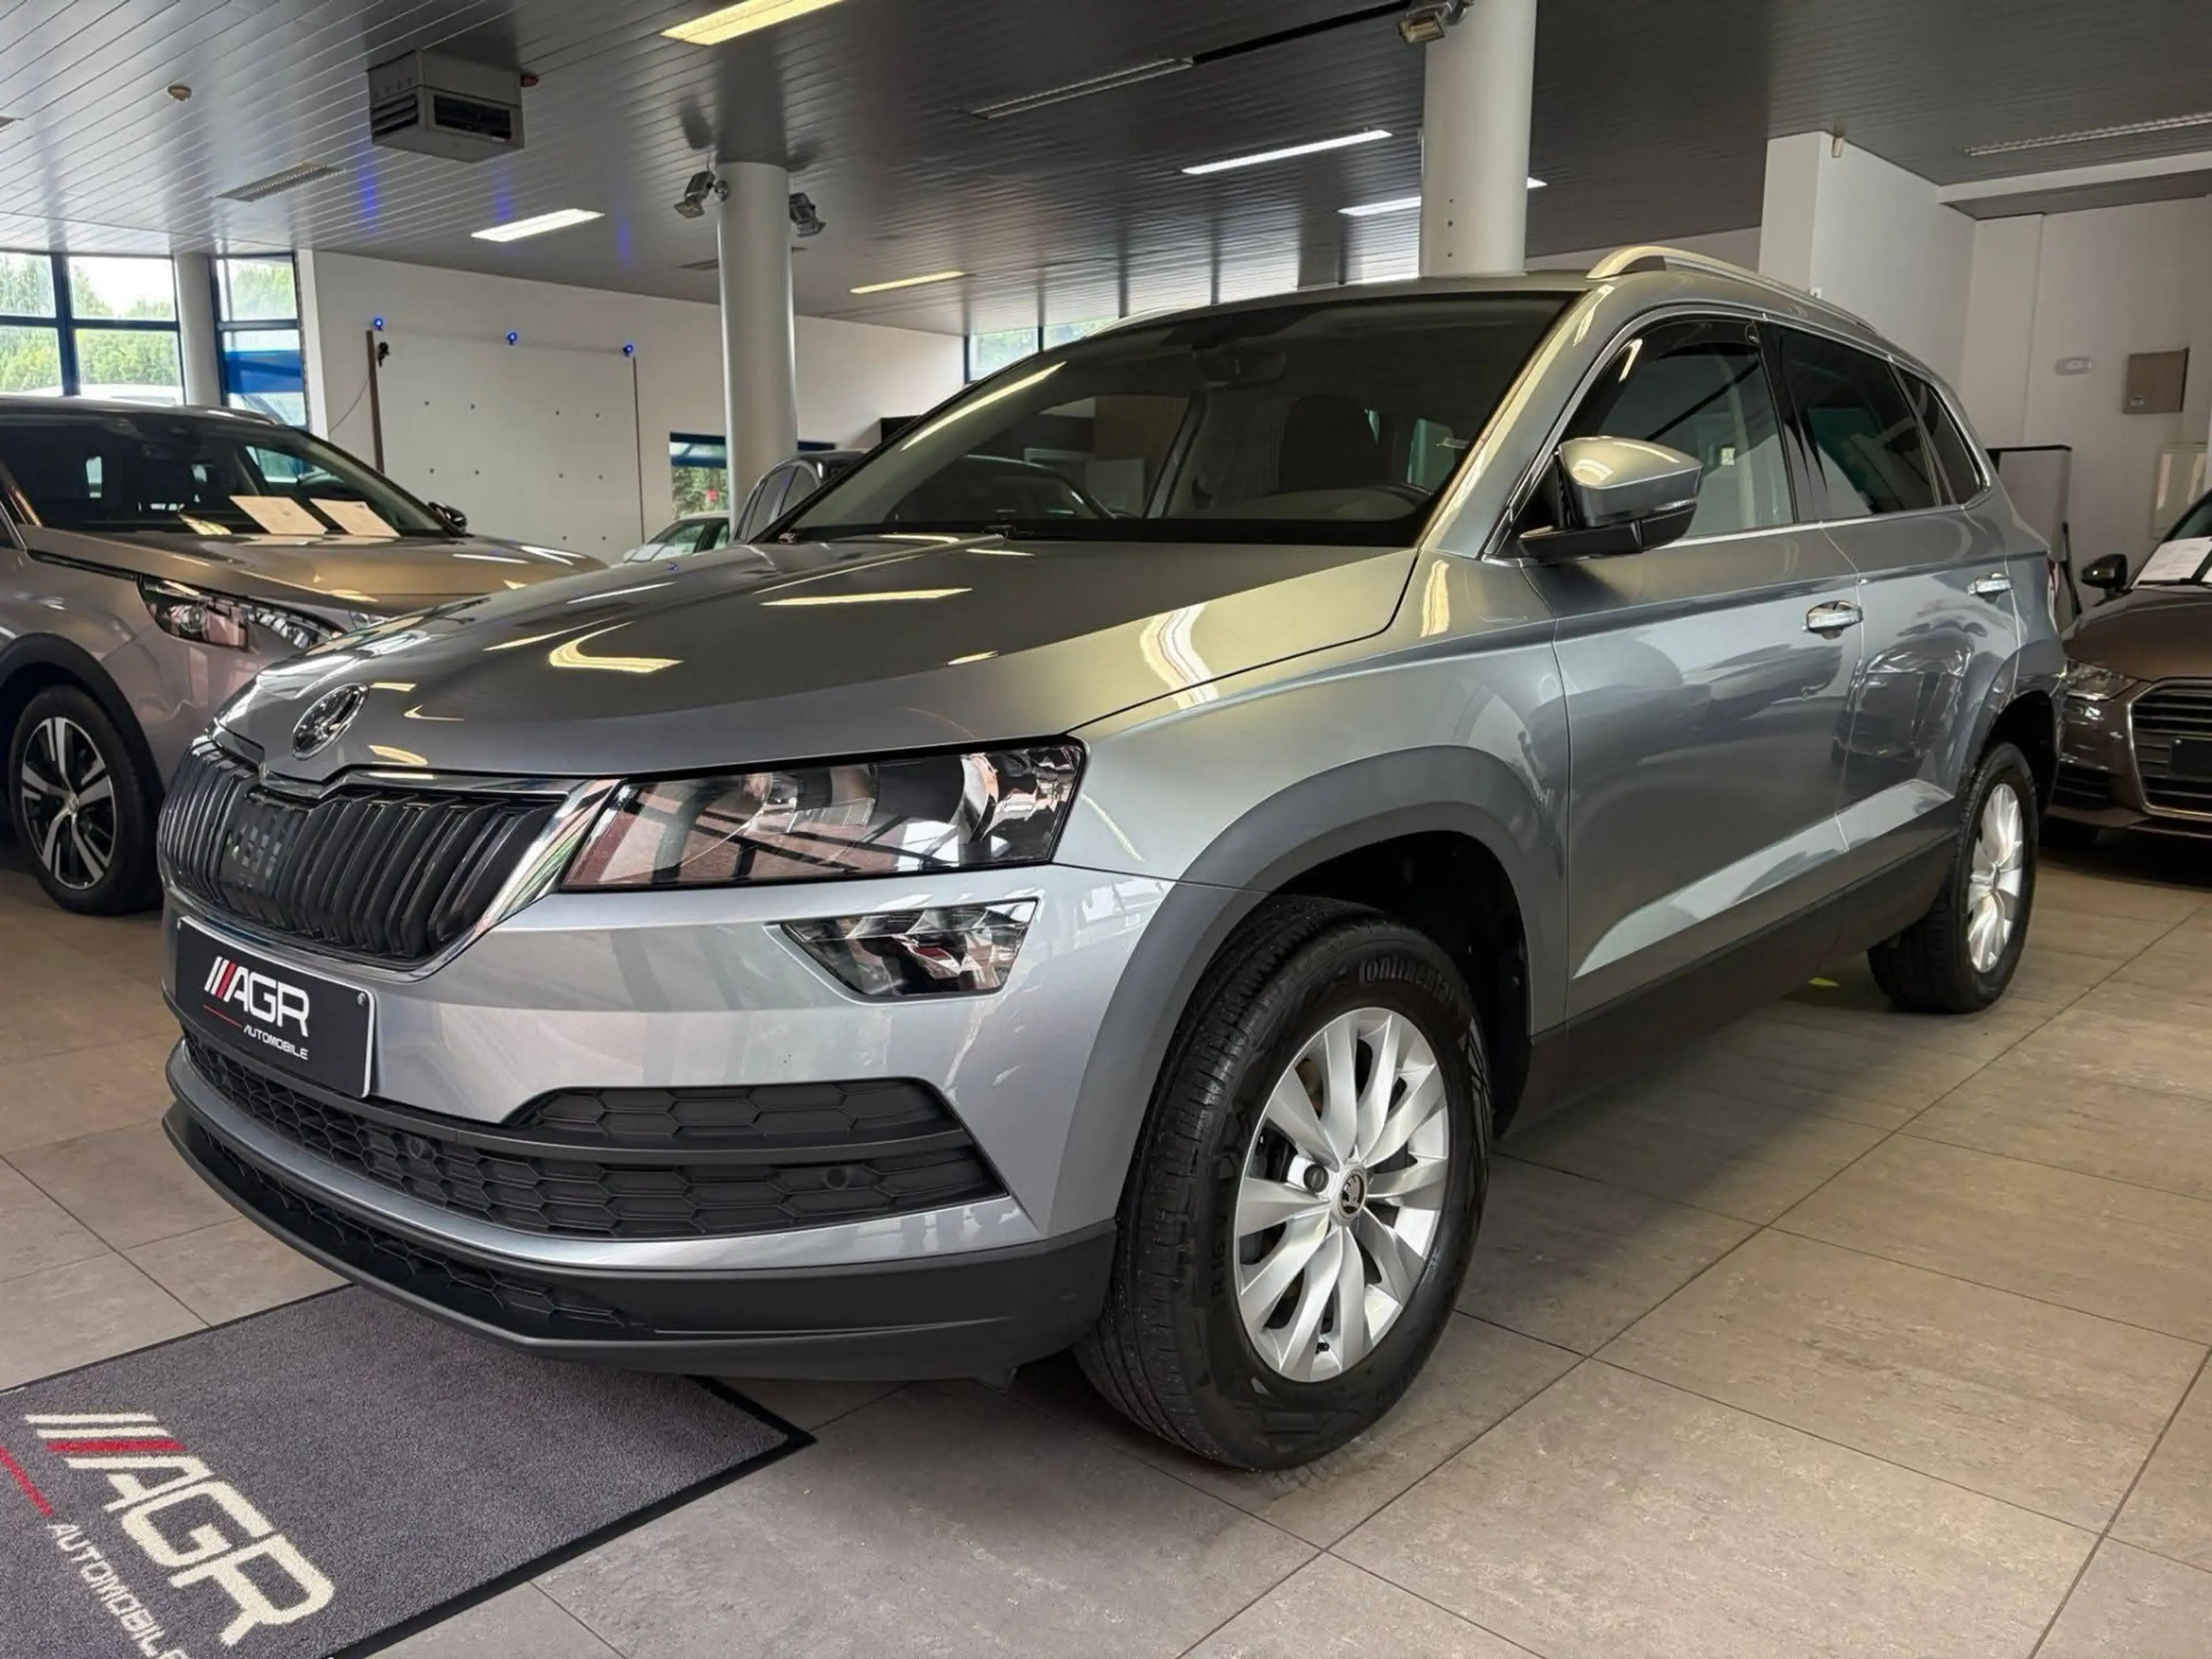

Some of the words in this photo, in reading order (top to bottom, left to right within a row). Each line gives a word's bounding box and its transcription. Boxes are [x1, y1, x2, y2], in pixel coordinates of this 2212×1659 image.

[222, 965, 310, 1037] AGR
[243, 1024, 309, 1060] AUTOMOBILE
[63, 1455, 335, 1646] AGR
